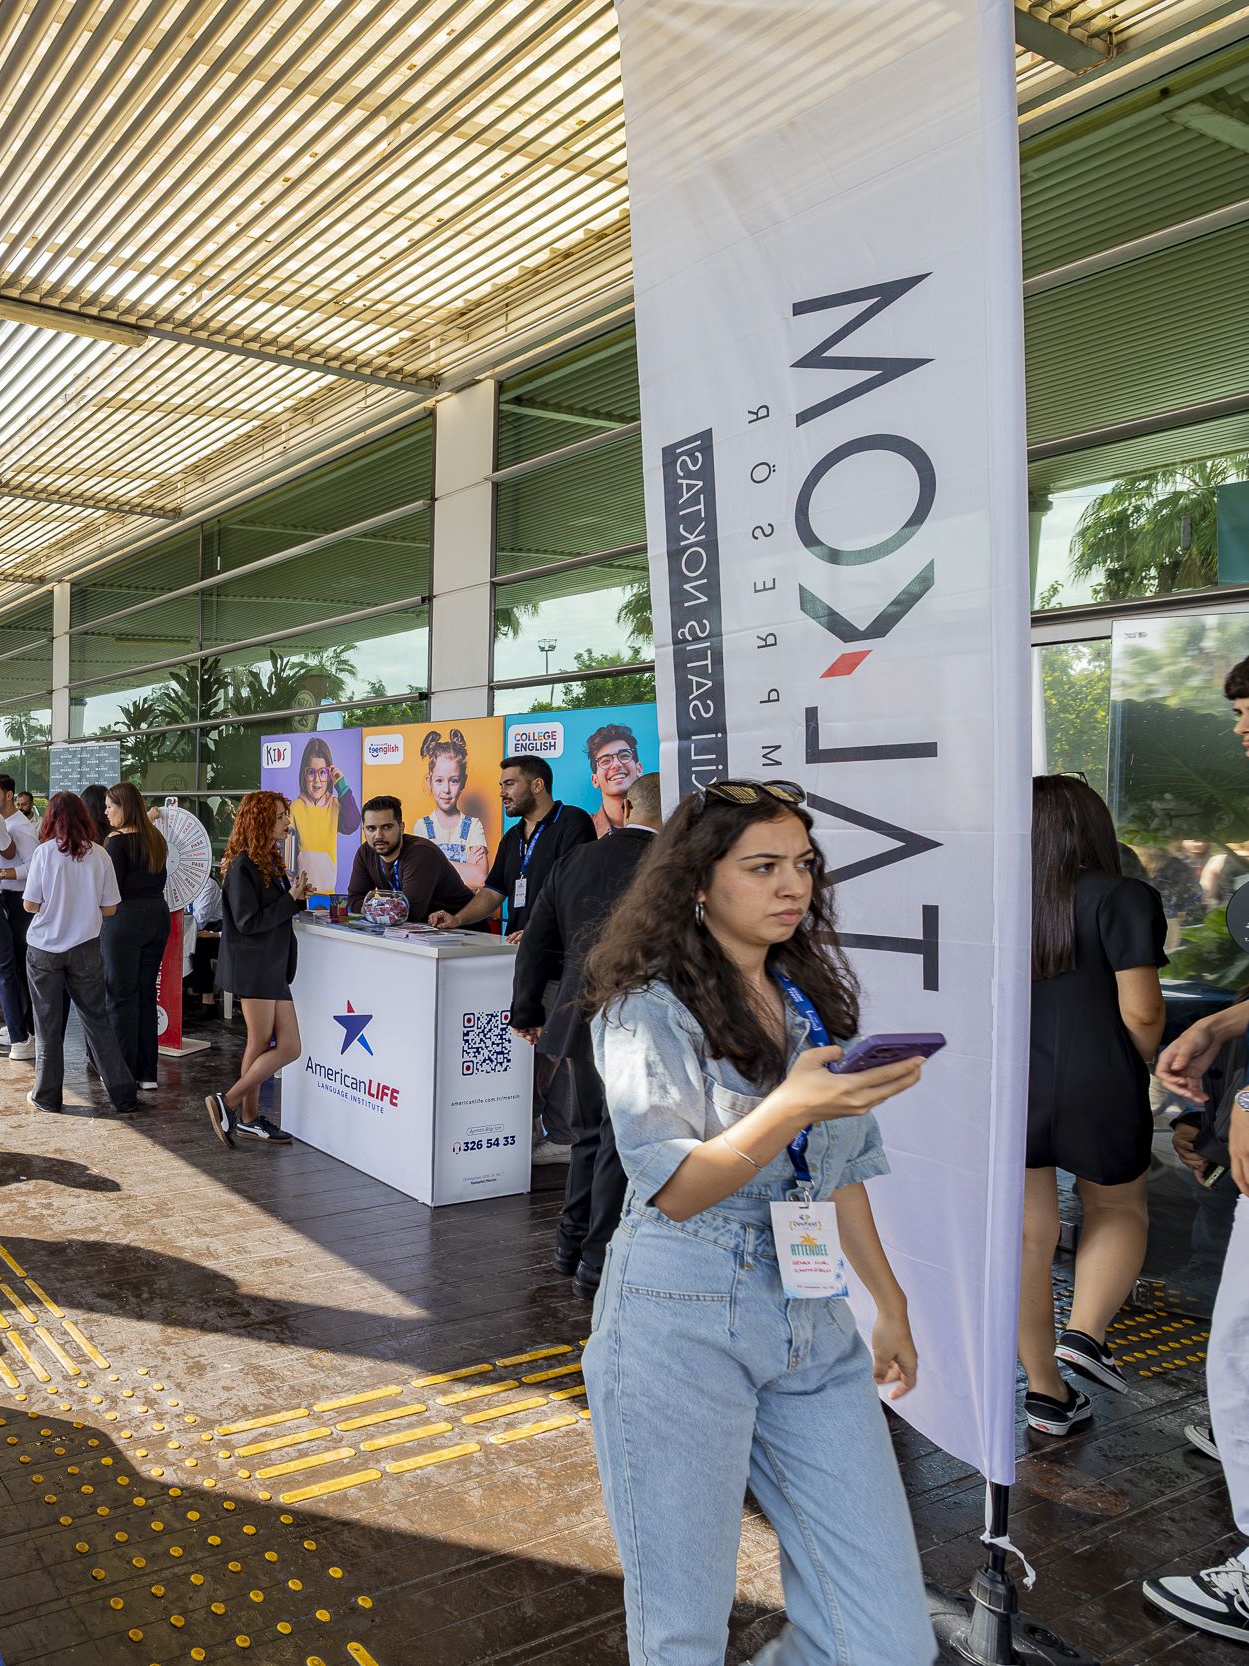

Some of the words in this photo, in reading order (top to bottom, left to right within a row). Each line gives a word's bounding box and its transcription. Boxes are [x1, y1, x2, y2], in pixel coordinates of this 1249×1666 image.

[514, 730, 557, 742] COLLEGE
[368, 743, 399, 755] teenglish
[514, 741, 557, 753] ENGLISH
[190, 840, 204, 850] PASS
[184, 877, 196, 890] PASS
[305, 1056, 400, 1108] AmericanLIFE
[317, 1080, 349, 1099] LANGUAGE
[350, 1094, 385, 1114] INSTITUTE
[462, 1140, 483, 1152] 326
[486, 1138, 500, 1148] 54
[502, 1135, 516, 1146] 33
[791, 1243, 829, 1256] ATTENDEE
